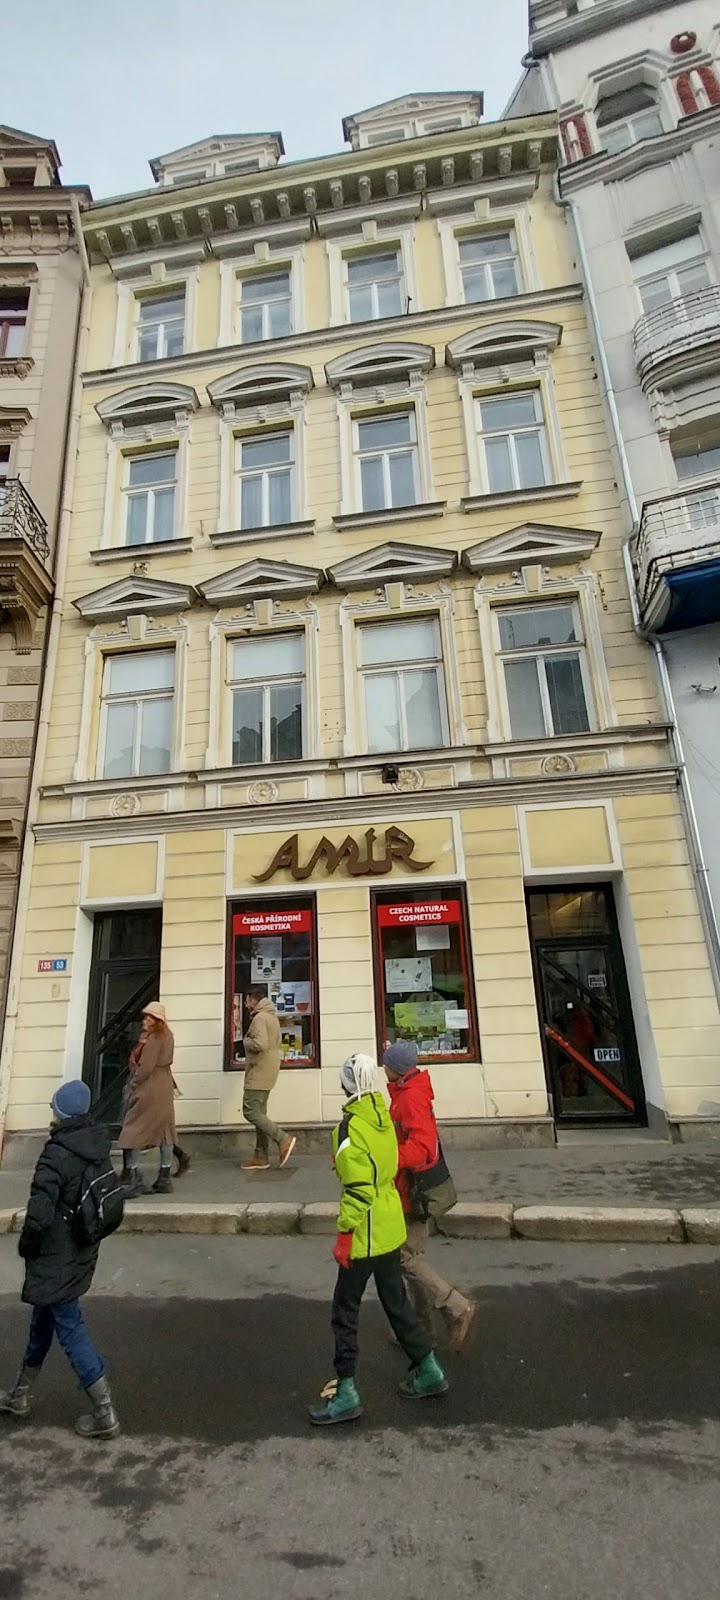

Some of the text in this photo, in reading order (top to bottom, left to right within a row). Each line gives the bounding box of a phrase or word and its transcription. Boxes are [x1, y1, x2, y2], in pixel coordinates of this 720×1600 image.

[389, 905, 449, 915] CZECH NATURAL
[242, 912, 302, 924] ČESKÁ PŘÍRODNÍ
[399, 913, 442, 922] COSMETICS
[250, 923, 291, 931] KOSMETIKA
[55, 960, 65, 970] 53
[597, 1049, 620, 1061] OPEN
